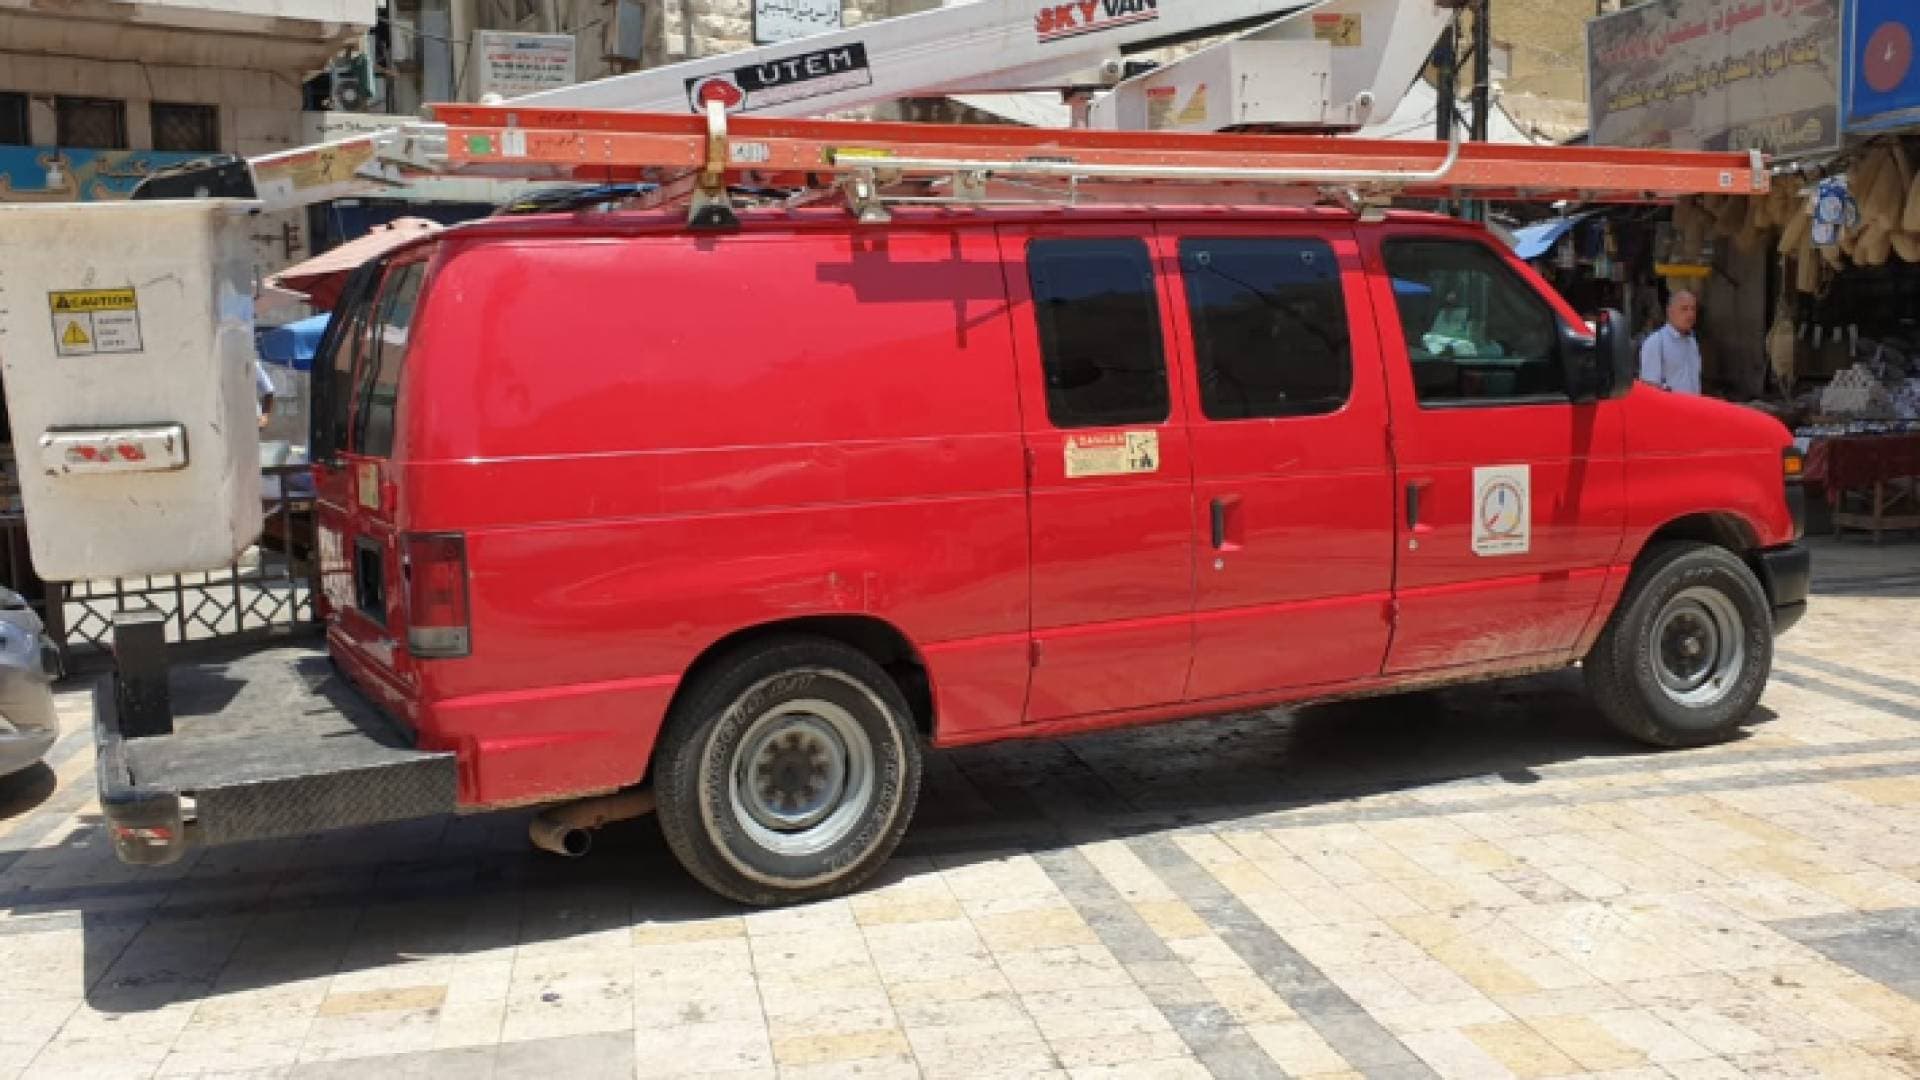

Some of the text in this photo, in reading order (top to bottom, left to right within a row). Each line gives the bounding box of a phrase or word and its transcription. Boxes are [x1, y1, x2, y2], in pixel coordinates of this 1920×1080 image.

[1034, 0, 1098, 33] SKY
[757, 49, 852, 83] UTEM
[71, 295, 134, 308] CAUTION
